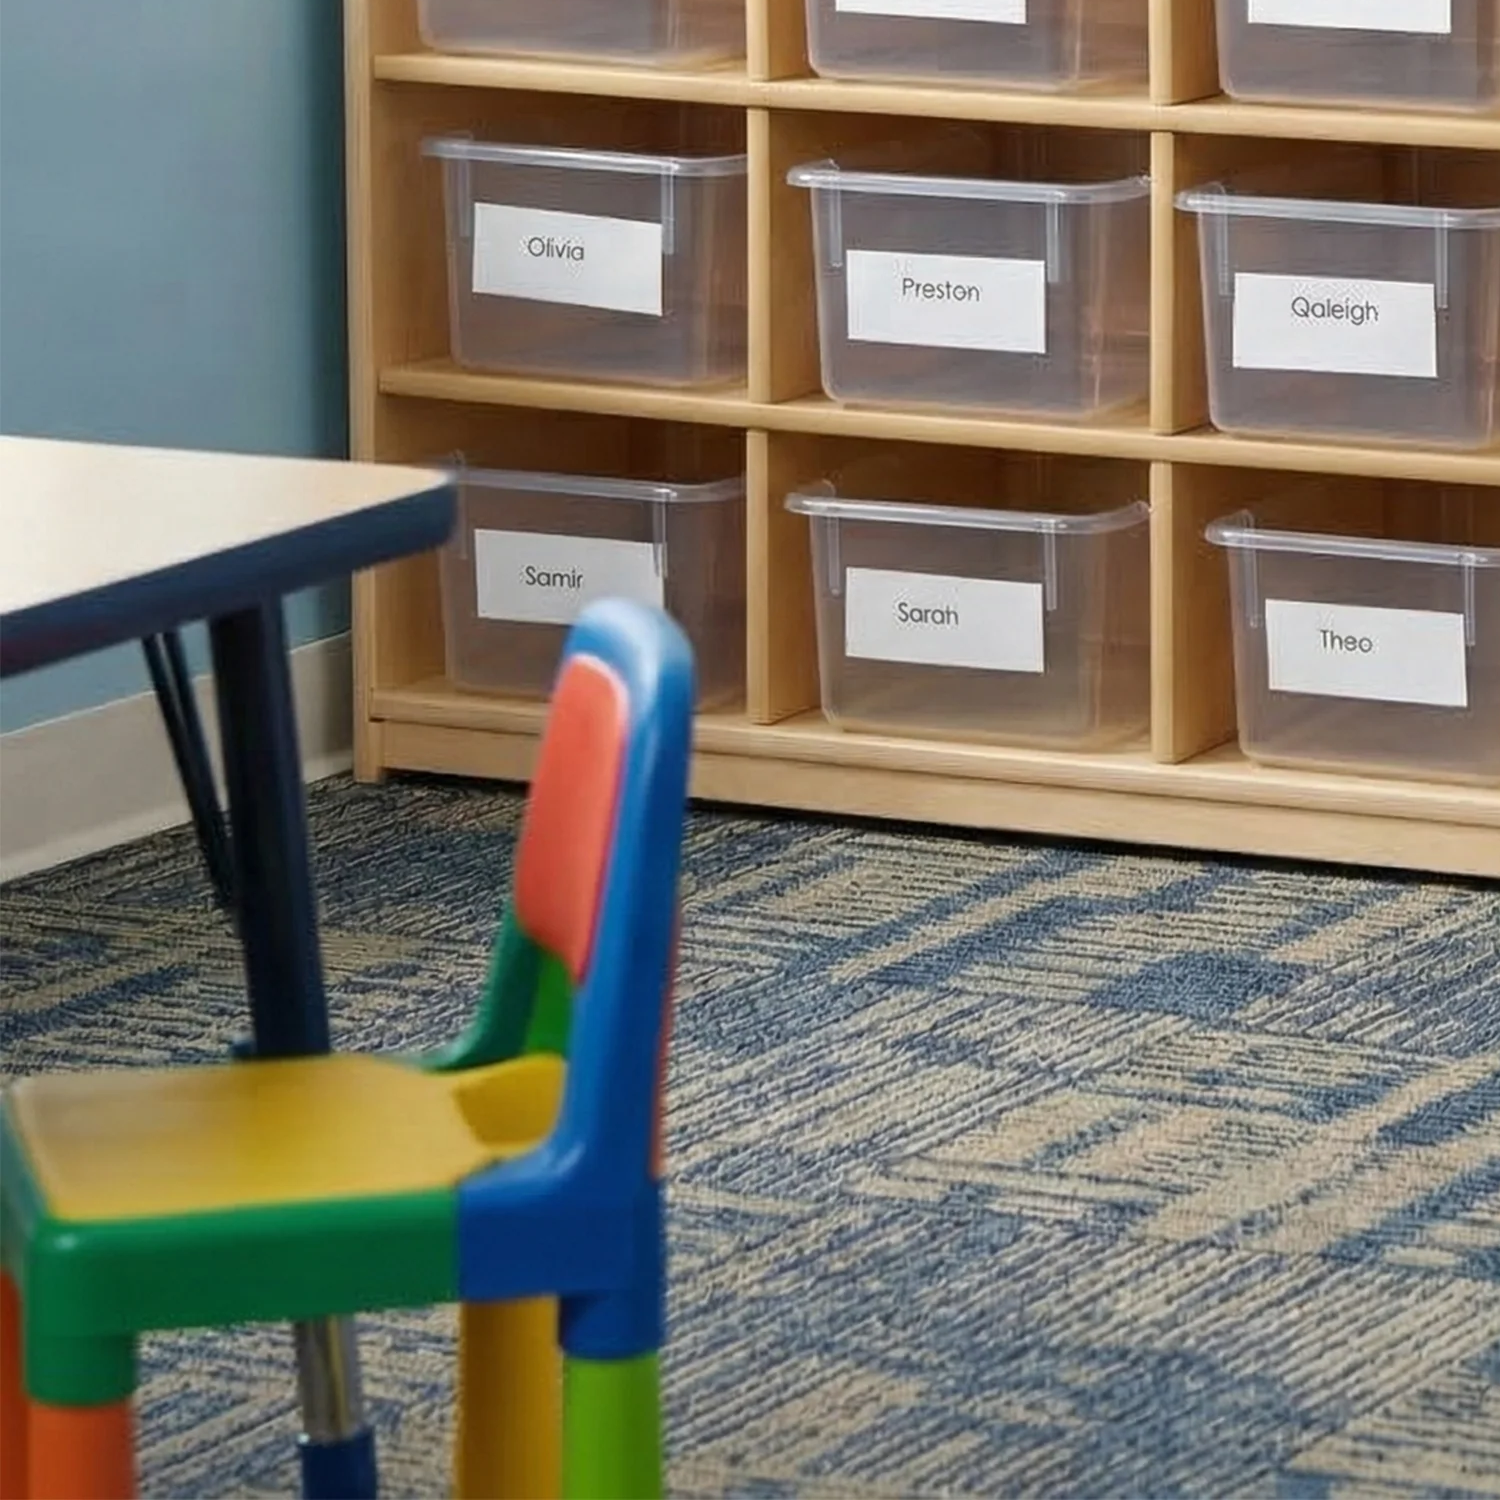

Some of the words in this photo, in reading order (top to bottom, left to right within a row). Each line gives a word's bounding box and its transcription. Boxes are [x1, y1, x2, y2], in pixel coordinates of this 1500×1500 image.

[526, 236, 585, 262] Olivia
[902, 277, 980, 302] Preston
[1290, 295, 1379, 327] Qaleigh
[525, 565, 584, 589] Samir
[897, 601, 959, 626] Sarah
[1319, 628, 1374, 654] Theo
